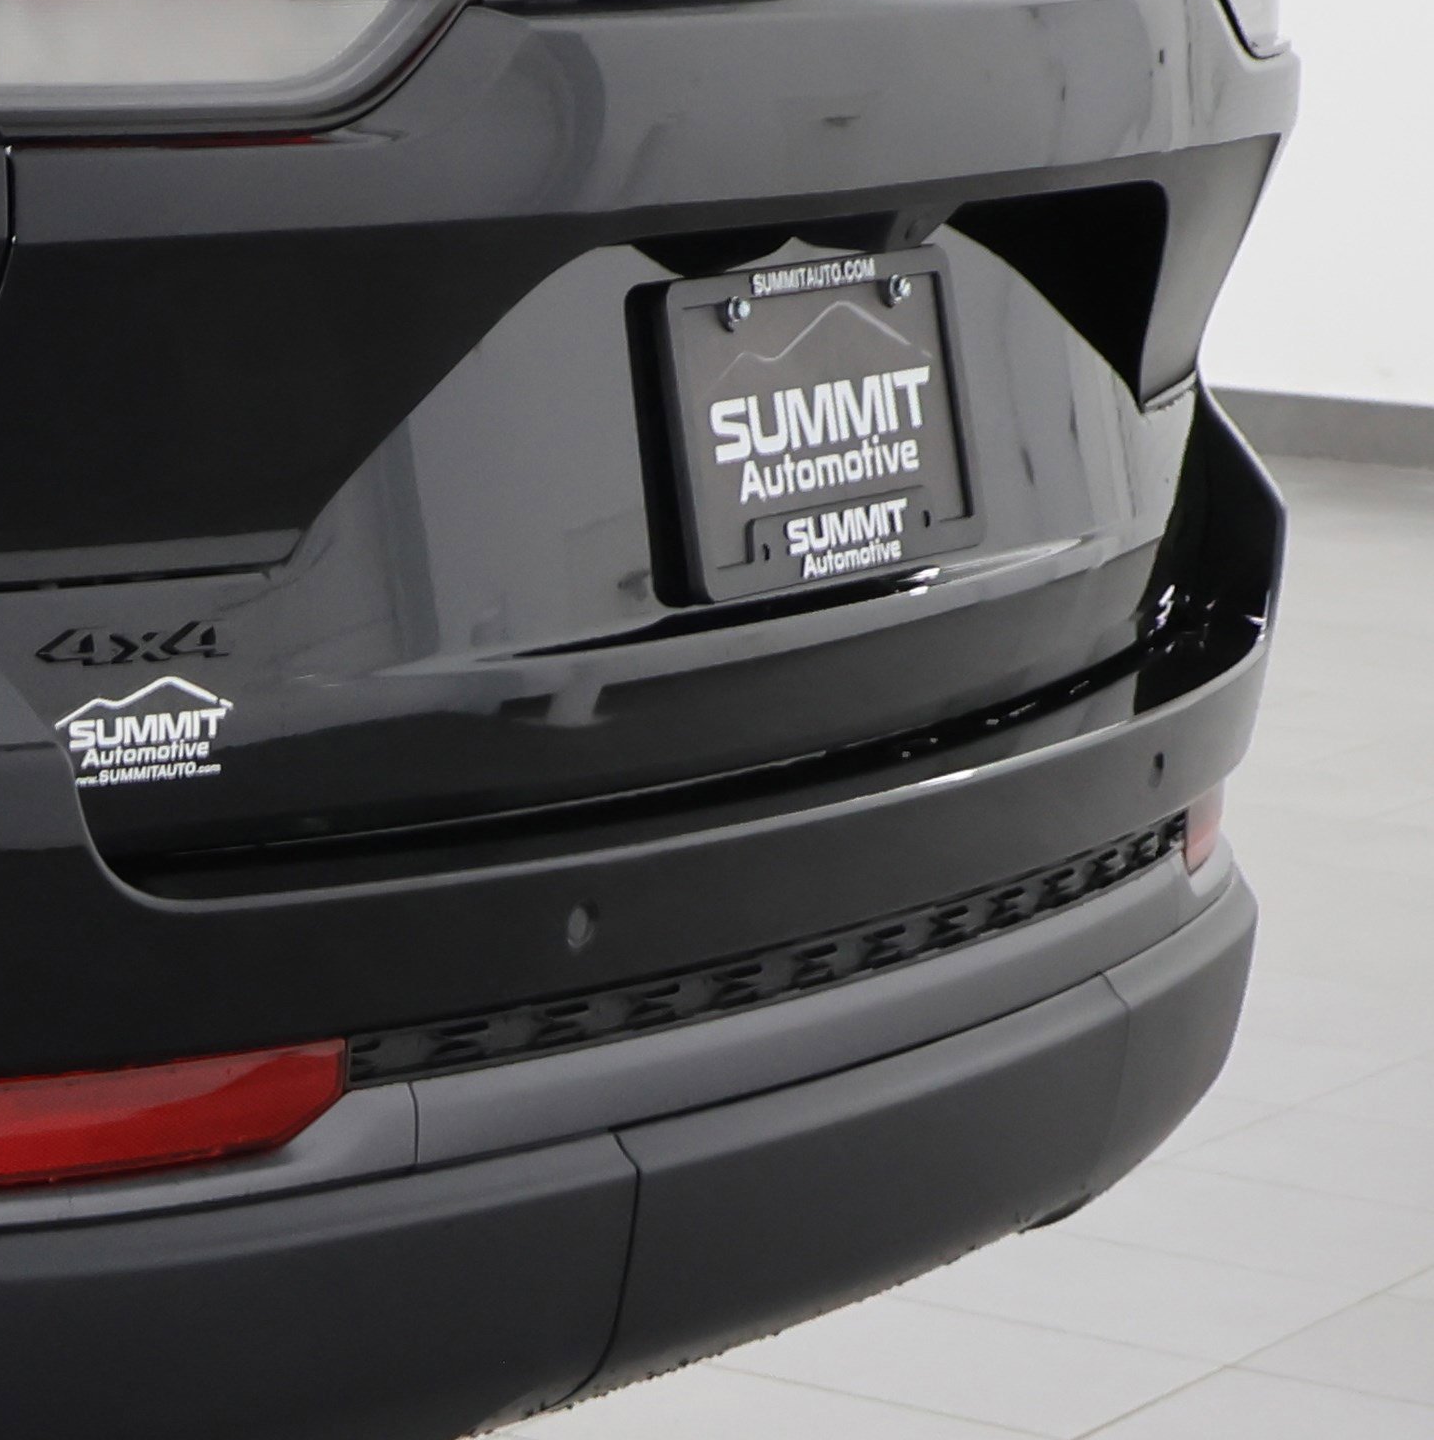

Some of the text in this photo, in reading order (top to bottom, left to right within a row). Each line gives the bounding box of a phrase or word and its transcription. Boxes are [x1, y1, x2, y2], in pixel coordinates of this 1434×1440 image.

[752, 258, 876, 297] SUMMITAUTO.COM
[709, 365, 931, 464] SUMMIT
[740, 433, 920, 504] Automotive
[786, 497, 907, 557] SUMMIT
[802, 538, 902, 580] Automotive
[68, 707, 227, 752] SUMMIT
[80, 739, 210, 770] Automotive
